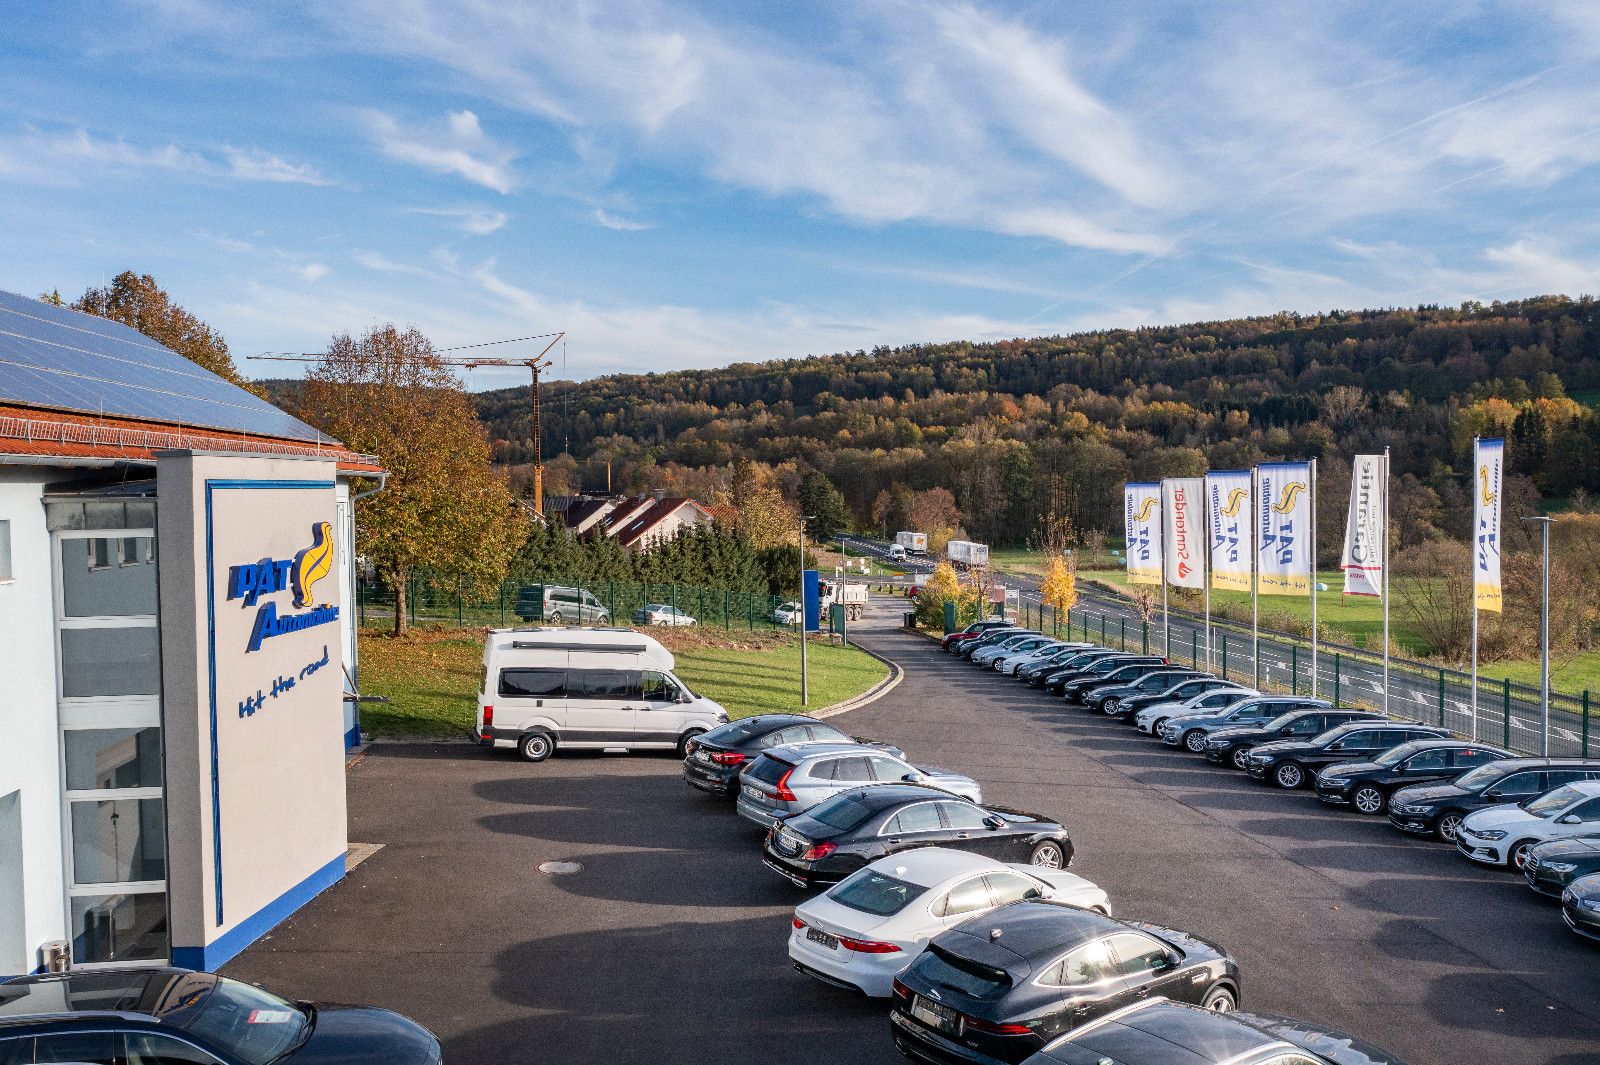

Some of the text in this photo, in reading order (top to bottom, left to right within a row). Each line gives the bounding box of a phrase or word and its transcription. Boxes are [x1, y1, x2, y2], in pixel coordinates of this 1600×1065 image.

[1479, 514, 1489, 572] PAT
[227, 557, 293, 609] PAT
[239, 645, 330, 719] Hit the road
